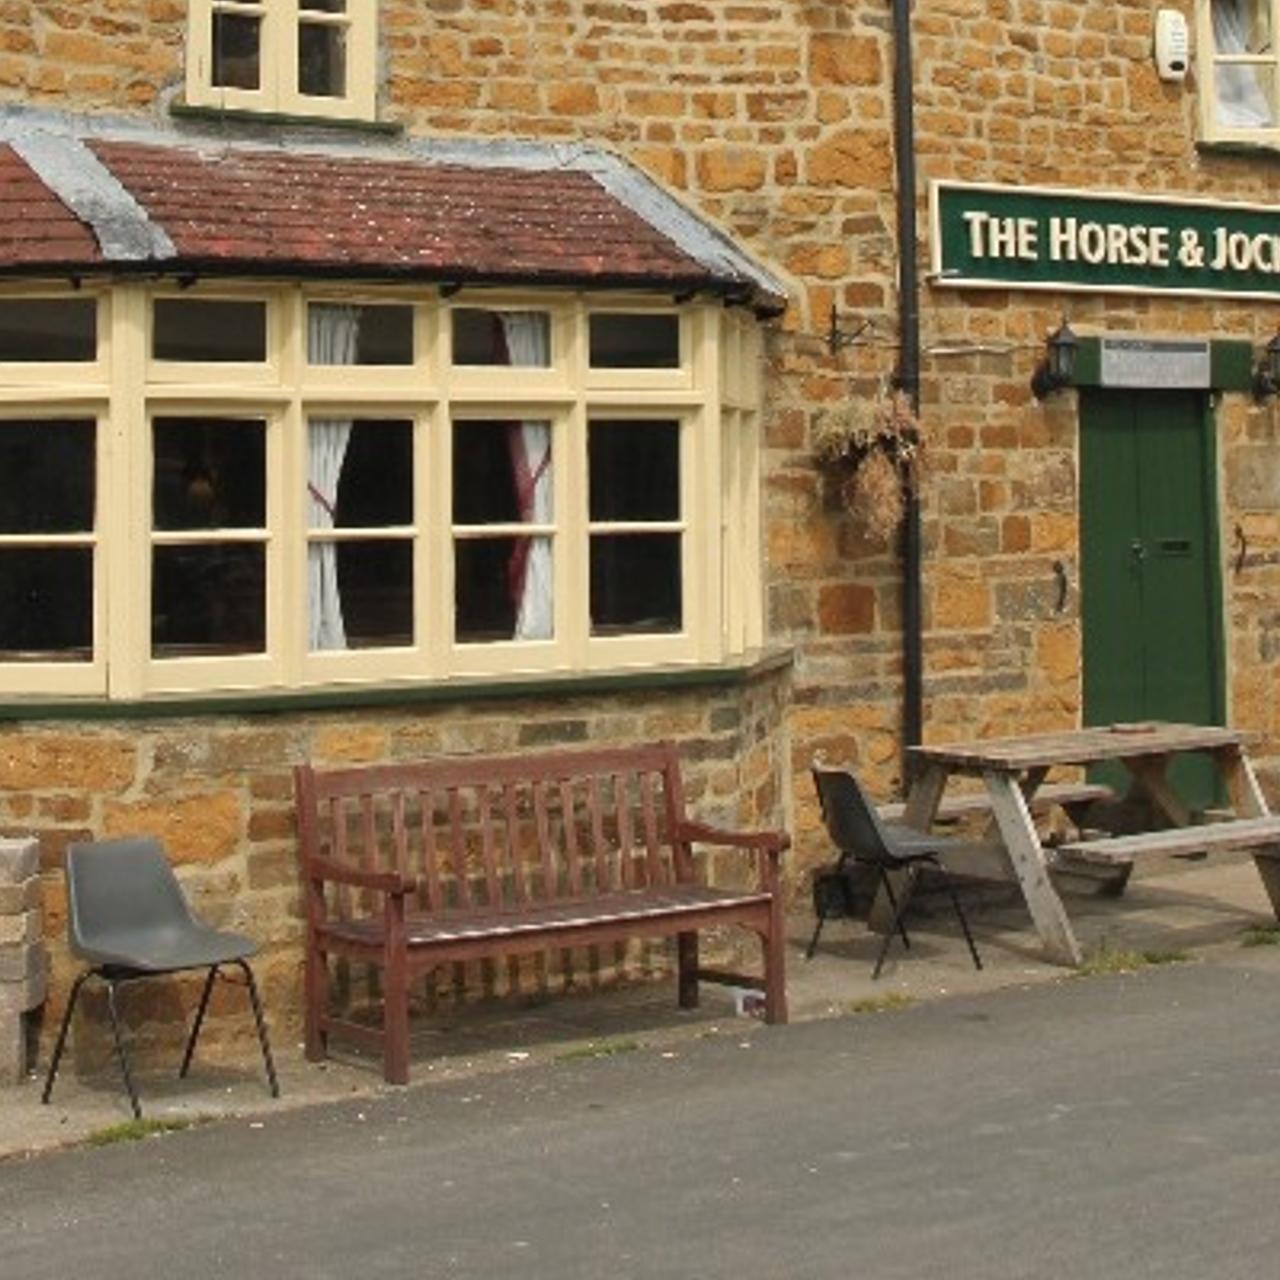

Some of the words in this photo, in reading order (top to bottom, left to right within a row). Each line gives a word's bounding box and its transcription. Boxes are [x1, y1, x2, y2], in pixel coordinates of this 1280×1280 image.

[962, 210, 1038, 260] THE
[1049, 217, 1170, 266] HORSE
[1177, 228, 1205, 268] &
